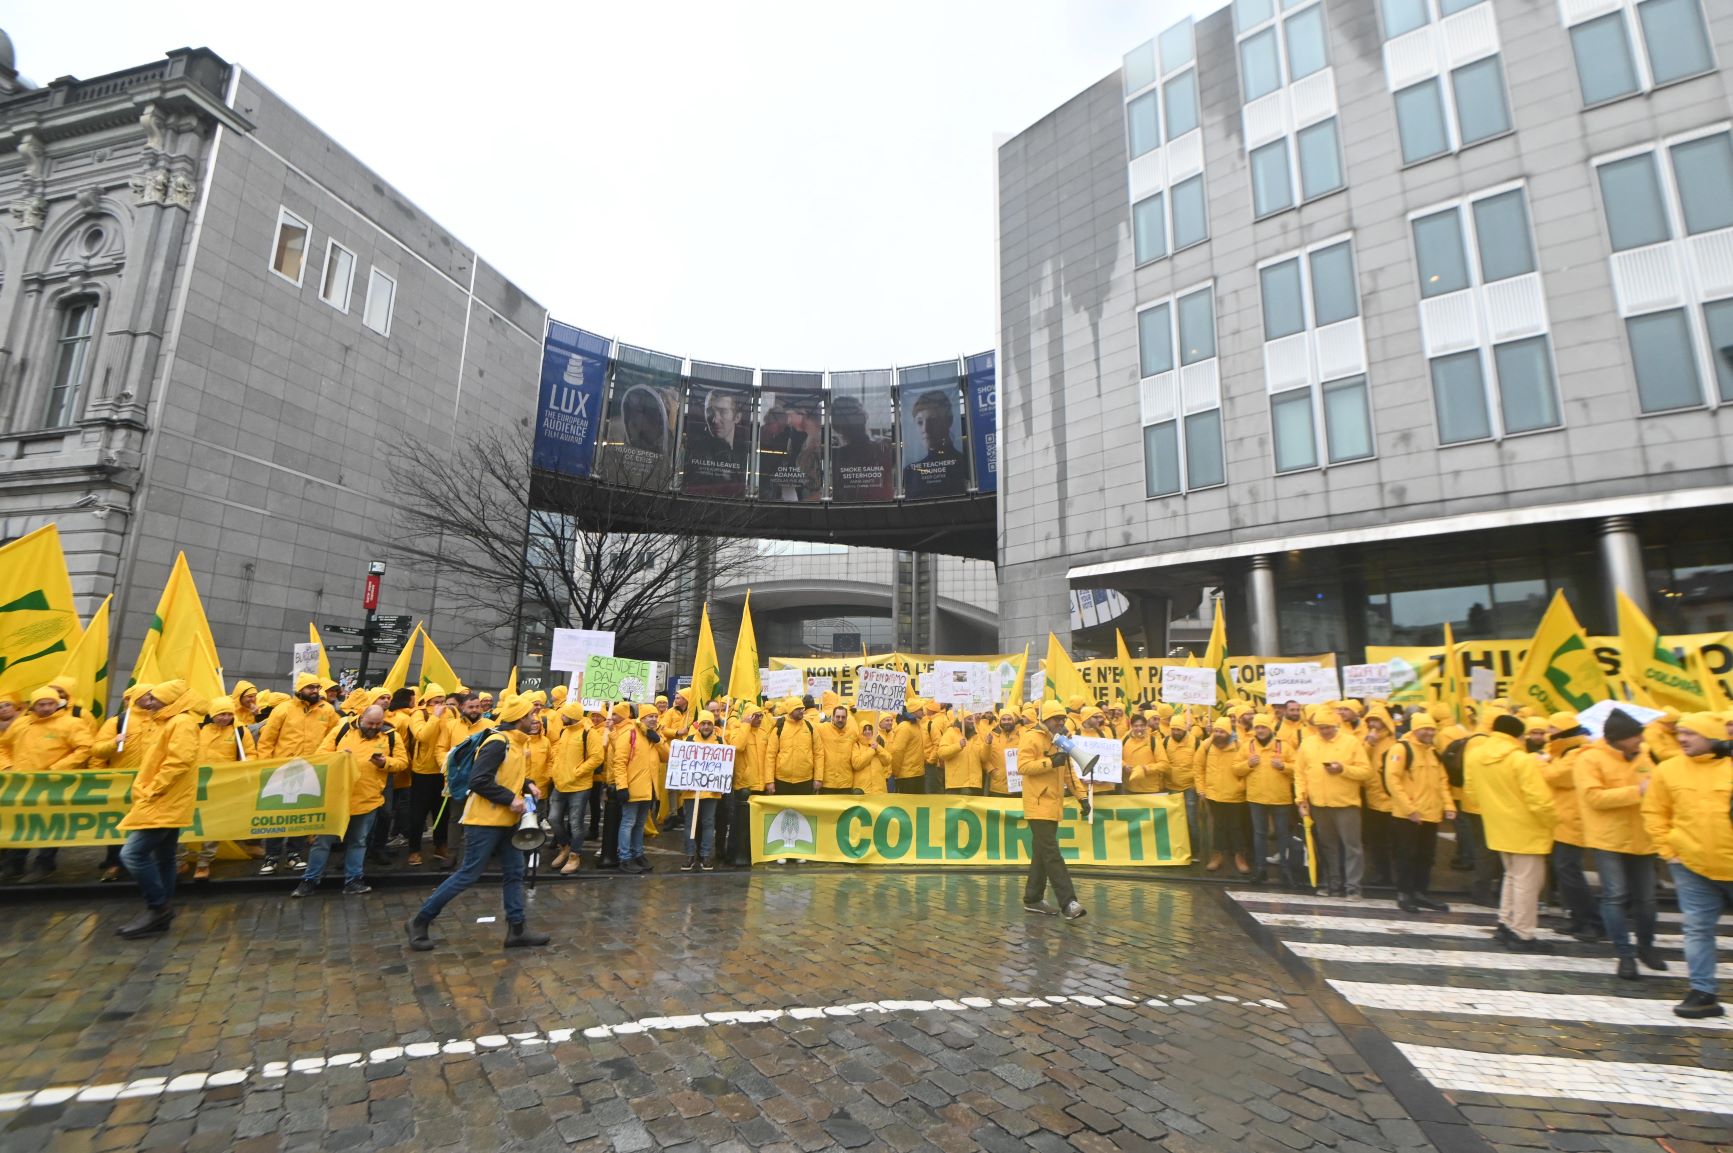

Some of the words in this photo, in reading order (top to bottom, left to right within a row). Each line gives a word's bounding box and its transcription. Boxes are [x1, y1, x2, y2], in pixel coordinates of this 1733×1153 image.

[549, 383, 590, 418] LUX
[544, 410, 557, 420] THE
[557, 412, 588, 428] EUROPEAN
[543, 417, 588, 438] AUDIENCE
[544, 430, 560, 438] FILM
[560, 433, 583, 445] AWARD
[691, 459, 716, 467] FALLEN
[716, 461, 741, 469] LEAVES
[911, 463, 923, 471] THE
[842, 472, 883, 480] SISTERHOOD
[590, 655, 650, 678] SCENDETE
[807, 667, 838, 678] NON
[841, 664, 852, 678] È
[592, 671, 616, 684] DAL
[584, 682, 619, 699] PERO
[857, 693, 905, 711] AGRICOLTURA
[689, 760, 722, 772] AMICA
[250, 812, 327, 827] COLDIRETTI
[250, 826, 287, 835] GIOVANI
[836, 805, 1171, 861] COLDIRETTI
